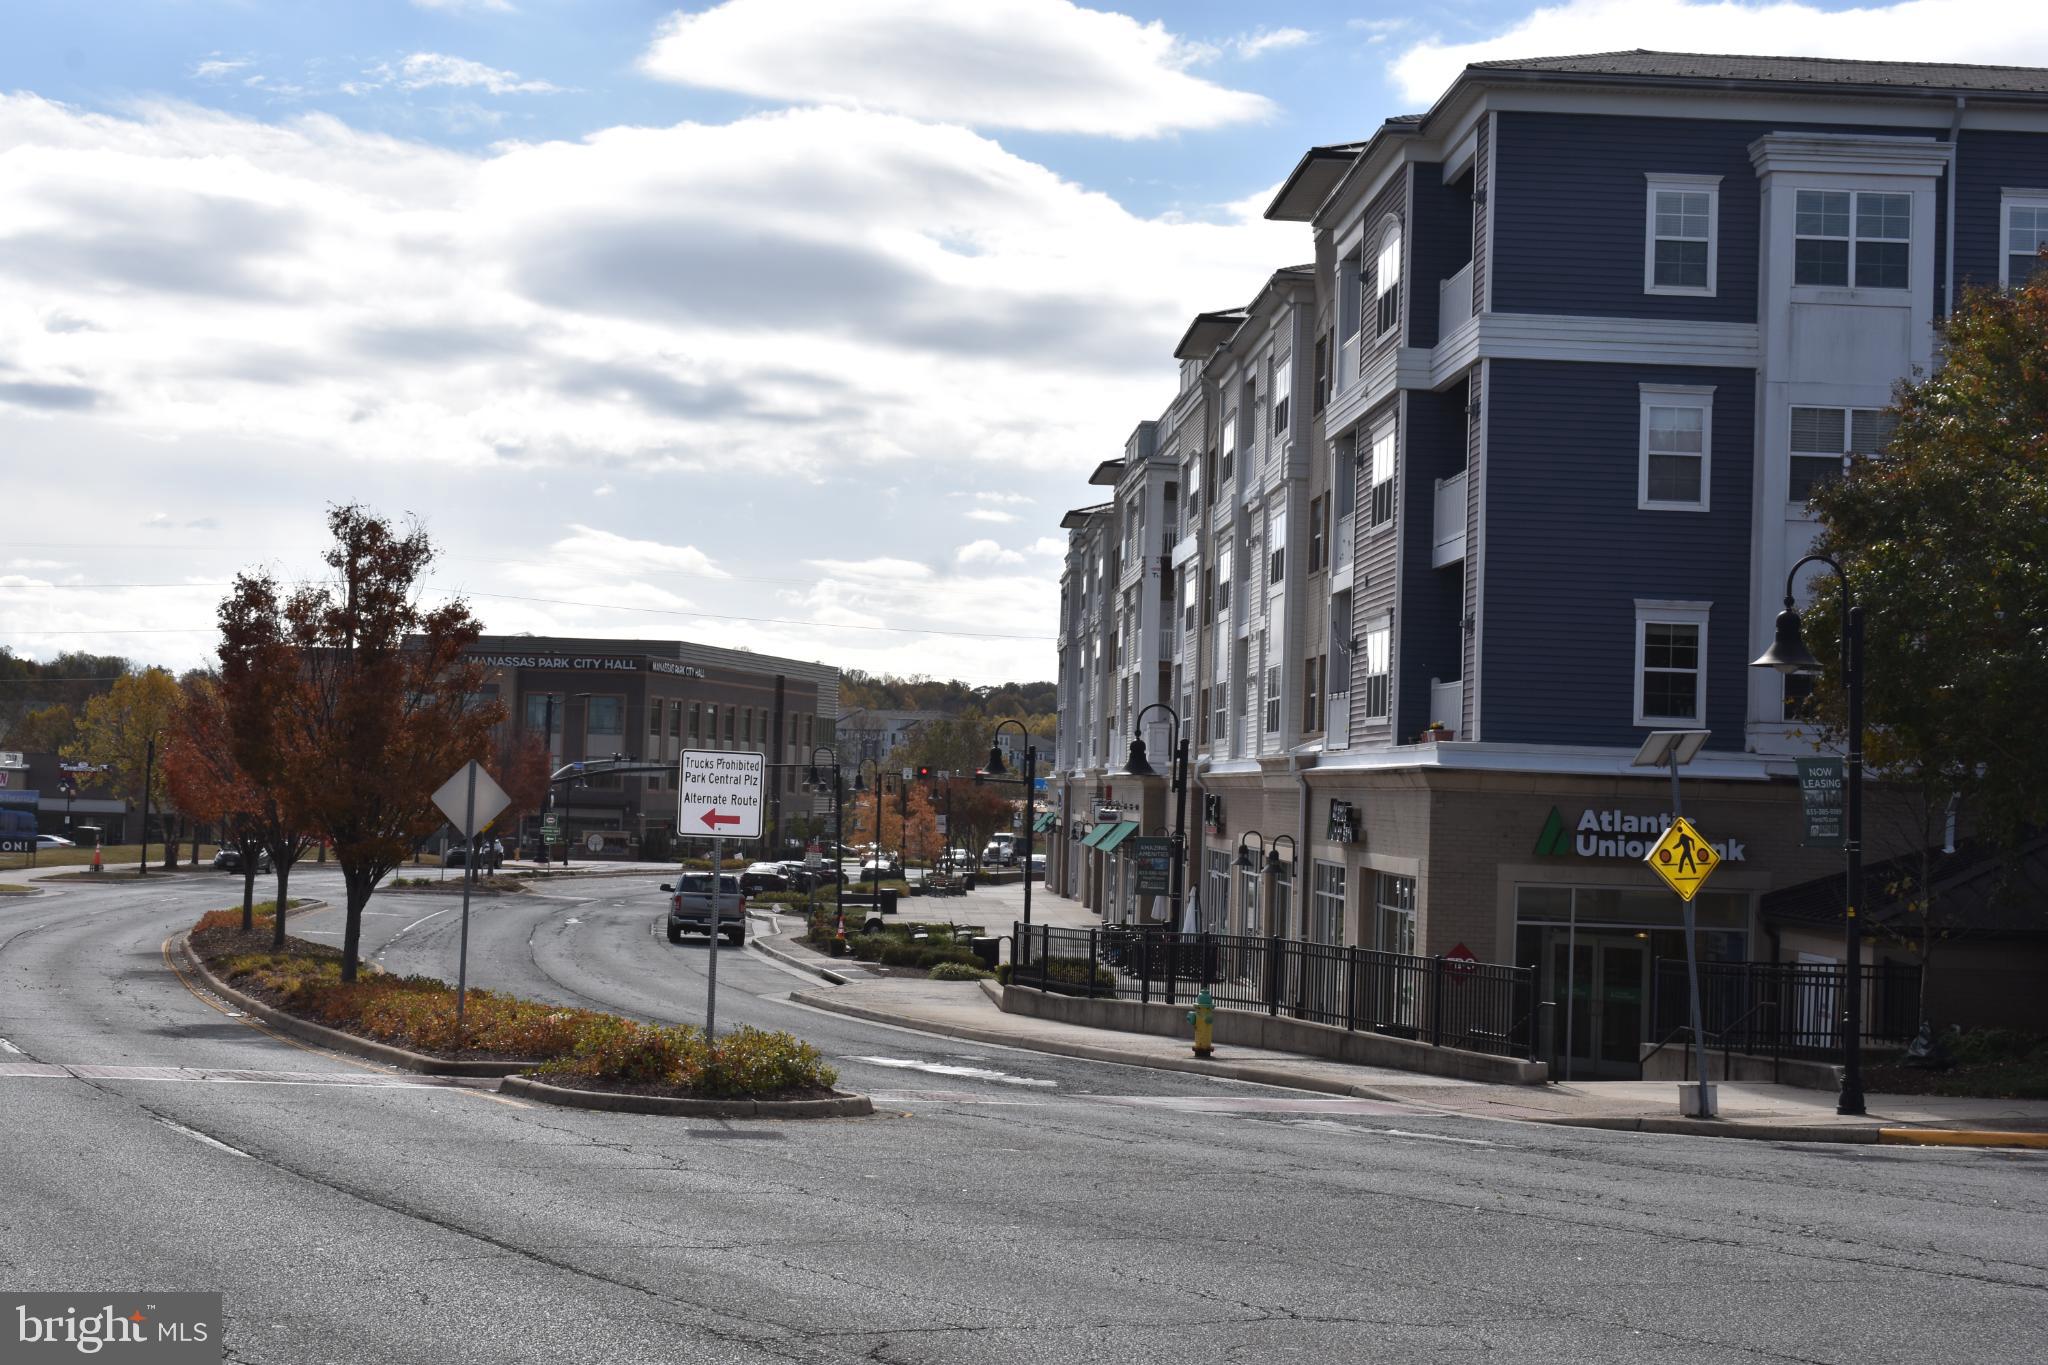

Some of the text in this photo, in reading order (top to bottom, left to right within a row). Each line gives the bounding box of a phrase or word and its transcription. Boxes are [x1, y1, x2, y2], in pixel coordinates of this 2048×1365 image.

[469, 656, 637, 670] MANASSAS PARK CITY HALL
[686, 757, 760, 772] Trucks Prohibited
[685, 772, 758, 786] Park Central Plz
[1808, 767, 1833, 777] NOW
[1802, 779, 1841, 789] LEASING
[684, 792, 758, 807] Alternate Route
[1576, 809, 1696, 833] Atlant
[2, 841, 28, 852] ON!
